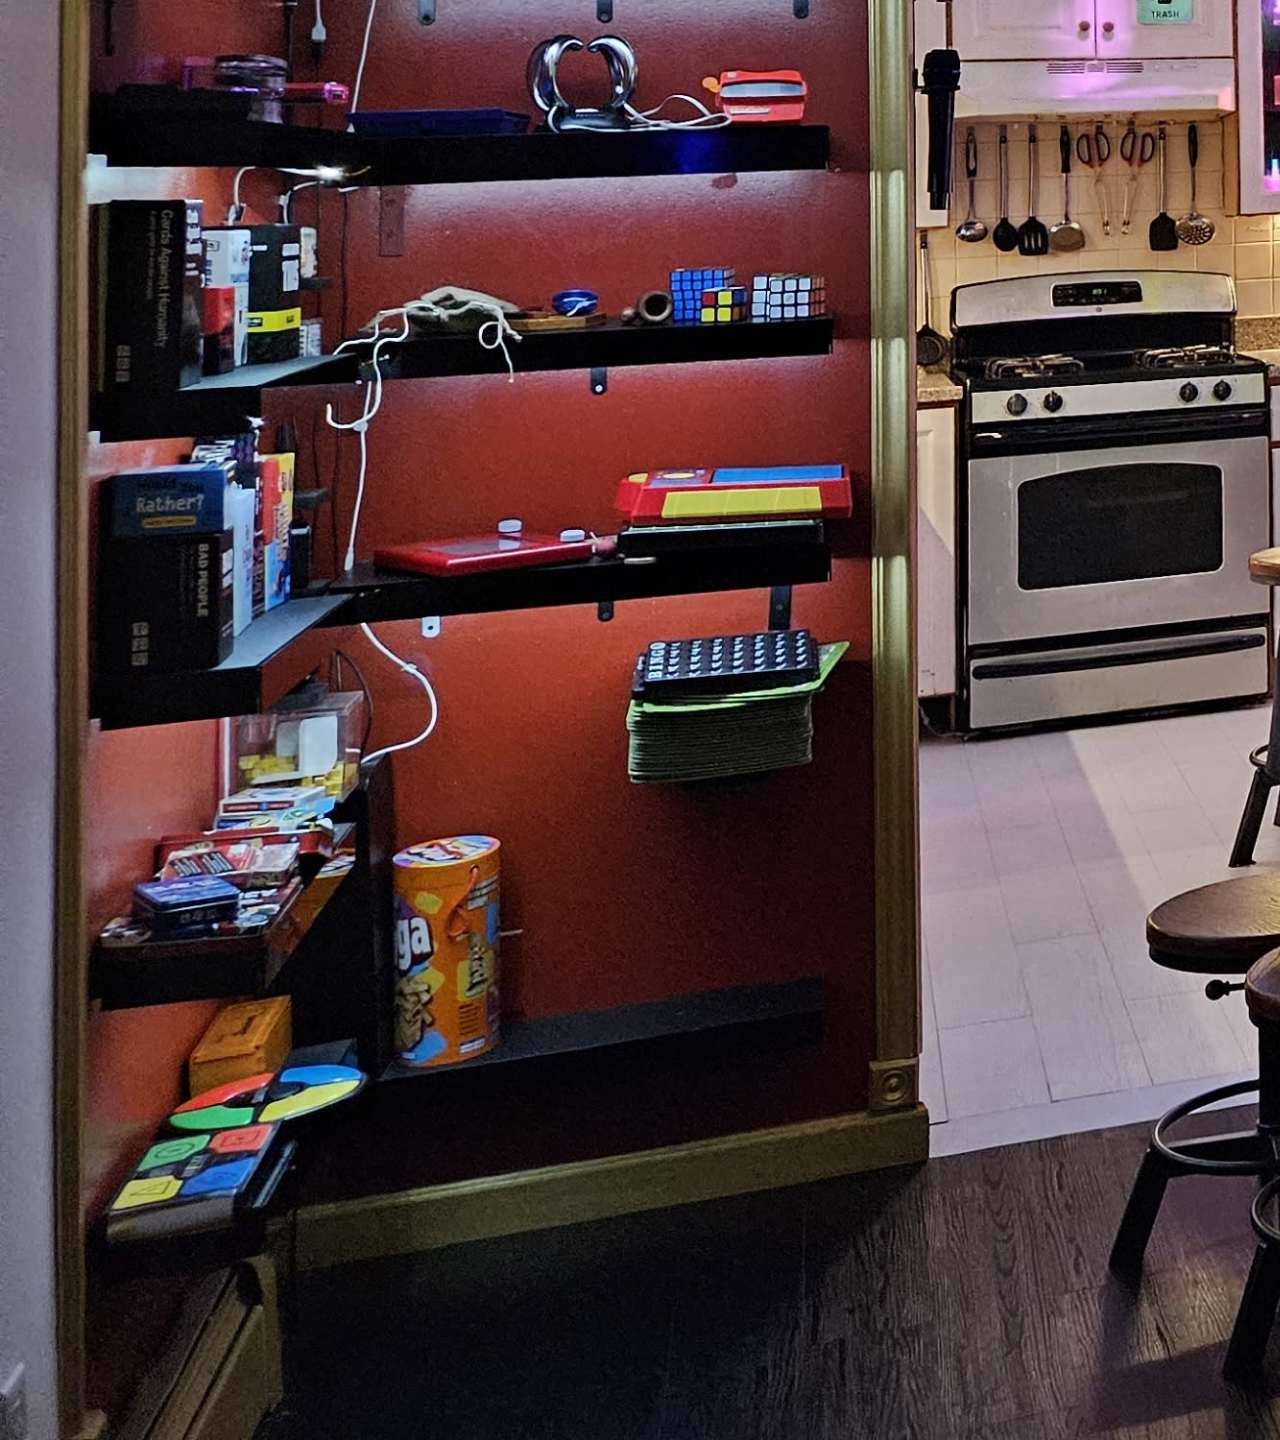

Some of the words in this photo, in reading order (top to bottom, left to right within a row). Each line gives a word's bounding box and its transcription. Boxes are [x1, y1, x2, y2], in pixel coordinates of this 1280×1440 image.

[1151, 10, 1179, 18] TRASH
[161, 209, 175, 246] Cards
[154, 285, 171, 348] Humanity
[136, 494, 205, 513] Rather?
[198, 543, 209, 568] BAD
[197, 570, 209, 618] PEOPLE
[648, 642, 666, 680] BINGO
